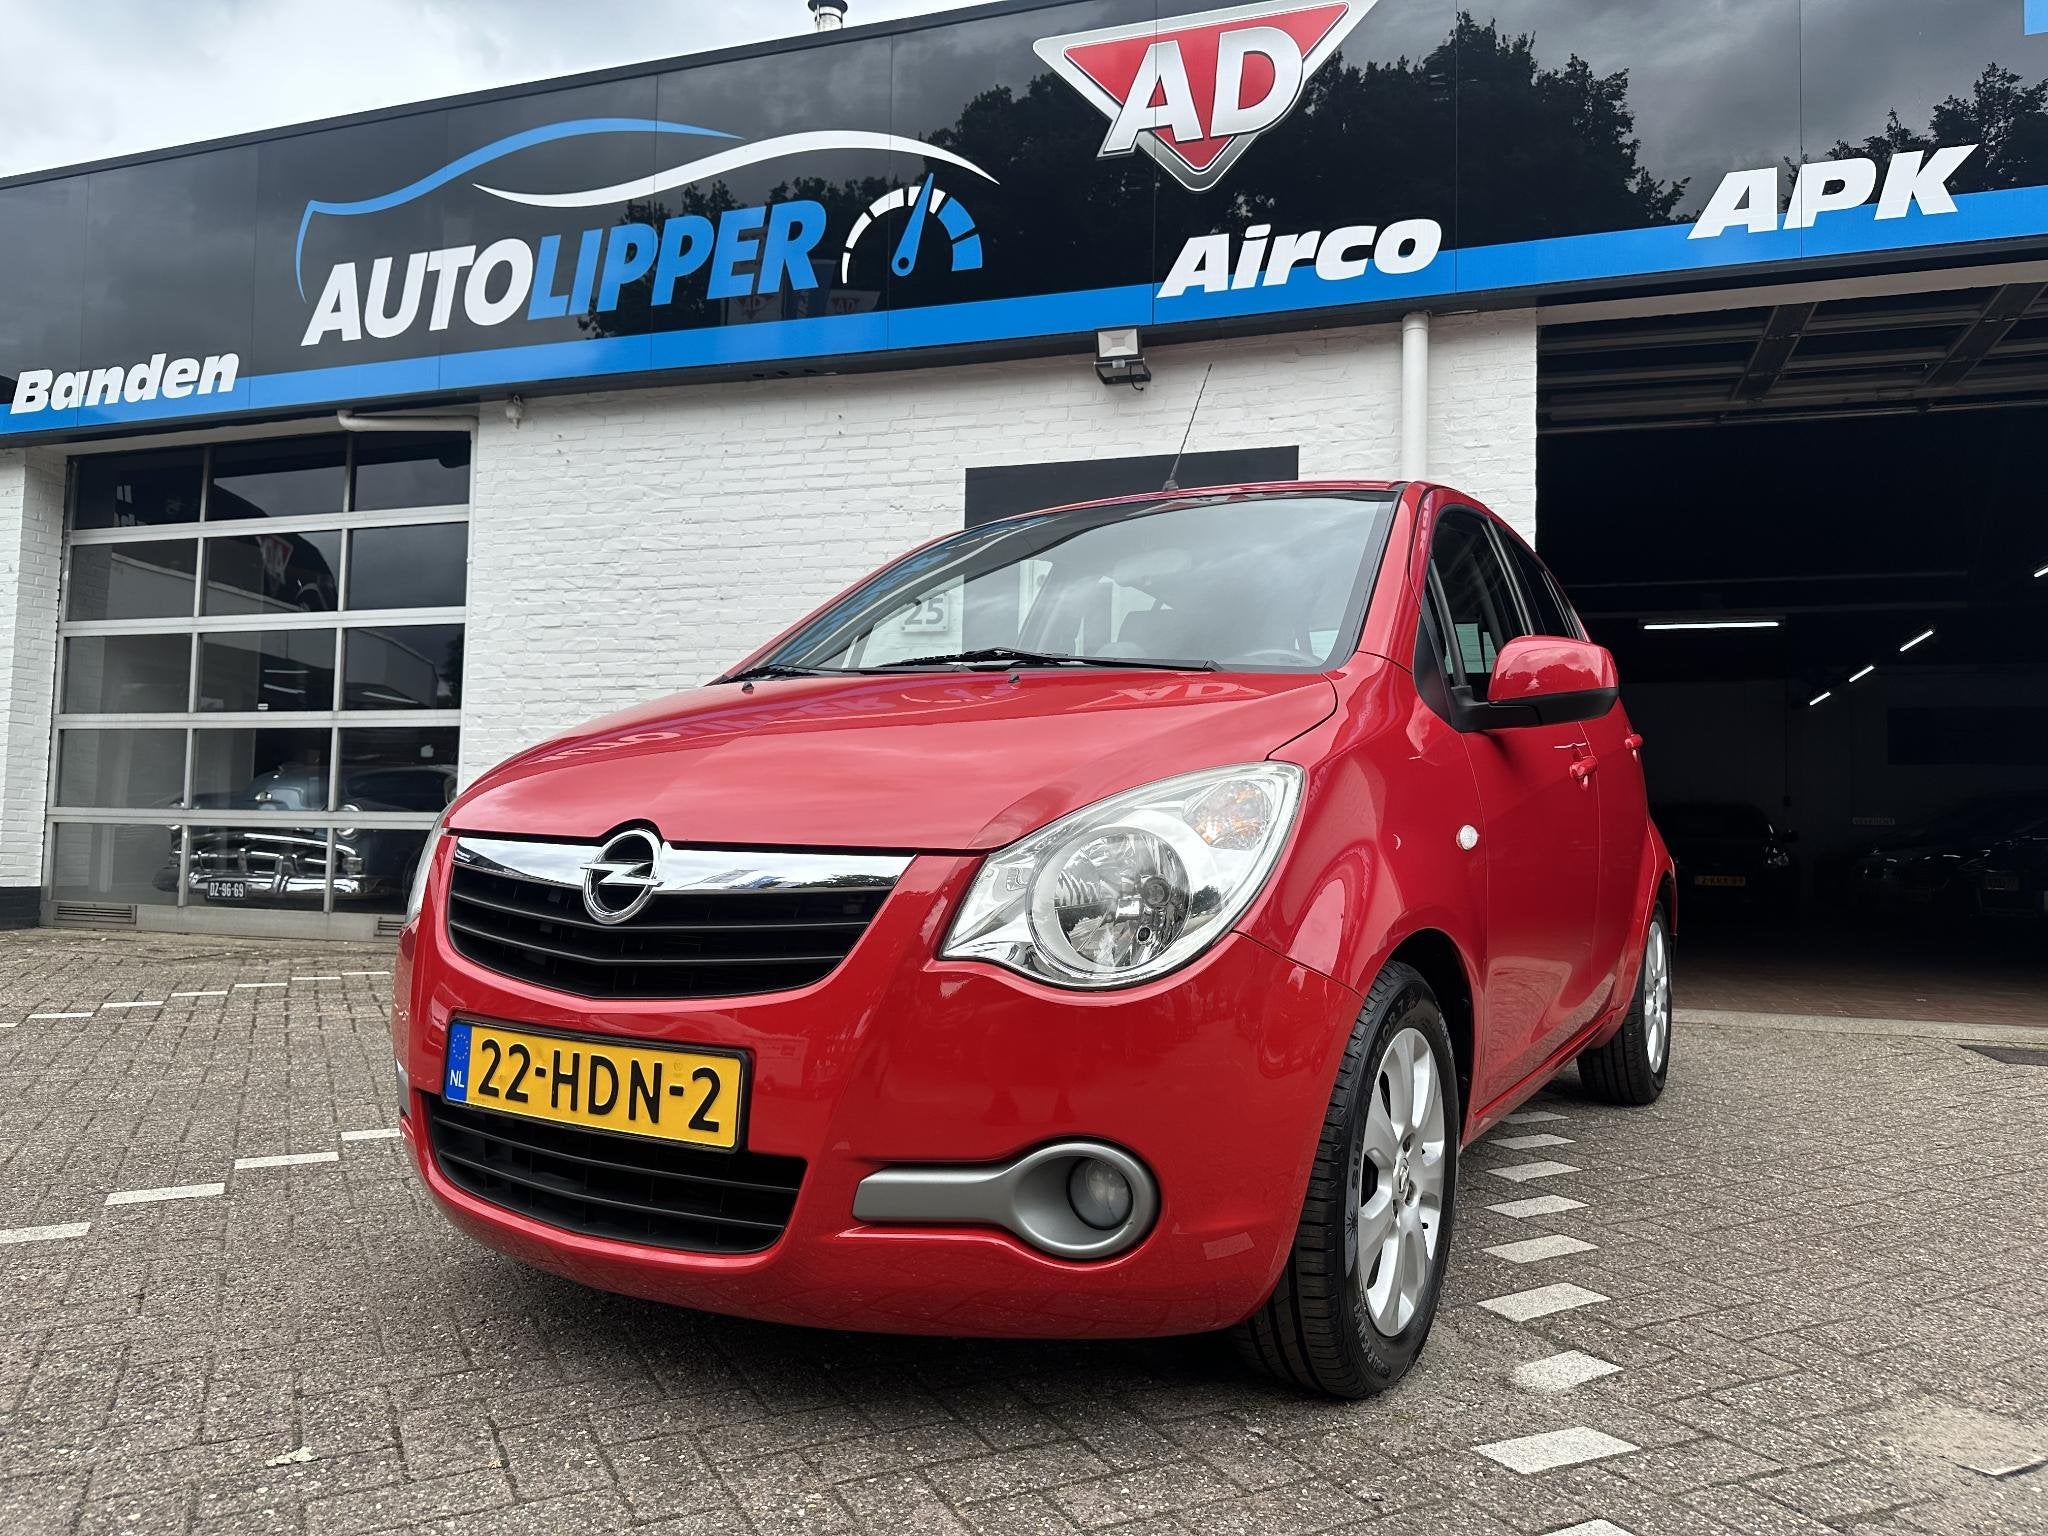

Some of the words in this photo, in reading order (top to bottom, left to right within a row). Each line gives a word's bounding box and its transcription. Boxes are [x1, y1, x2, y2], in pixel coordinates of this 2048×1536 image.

[1097, 26, 1303, 157] AD
[1687, 144, 1979, 240] APK
[301, 200, 827, 346] AUTOLIPPER
[1156, 218, 1442, 298] Airco
[10, 353, 240, 414] Banden
[209, 882, 244, 897] DZ-96-69
[450, 1070, 464, 1088] NL
[478, 1039, 720, 1132] 22-HDN-2
